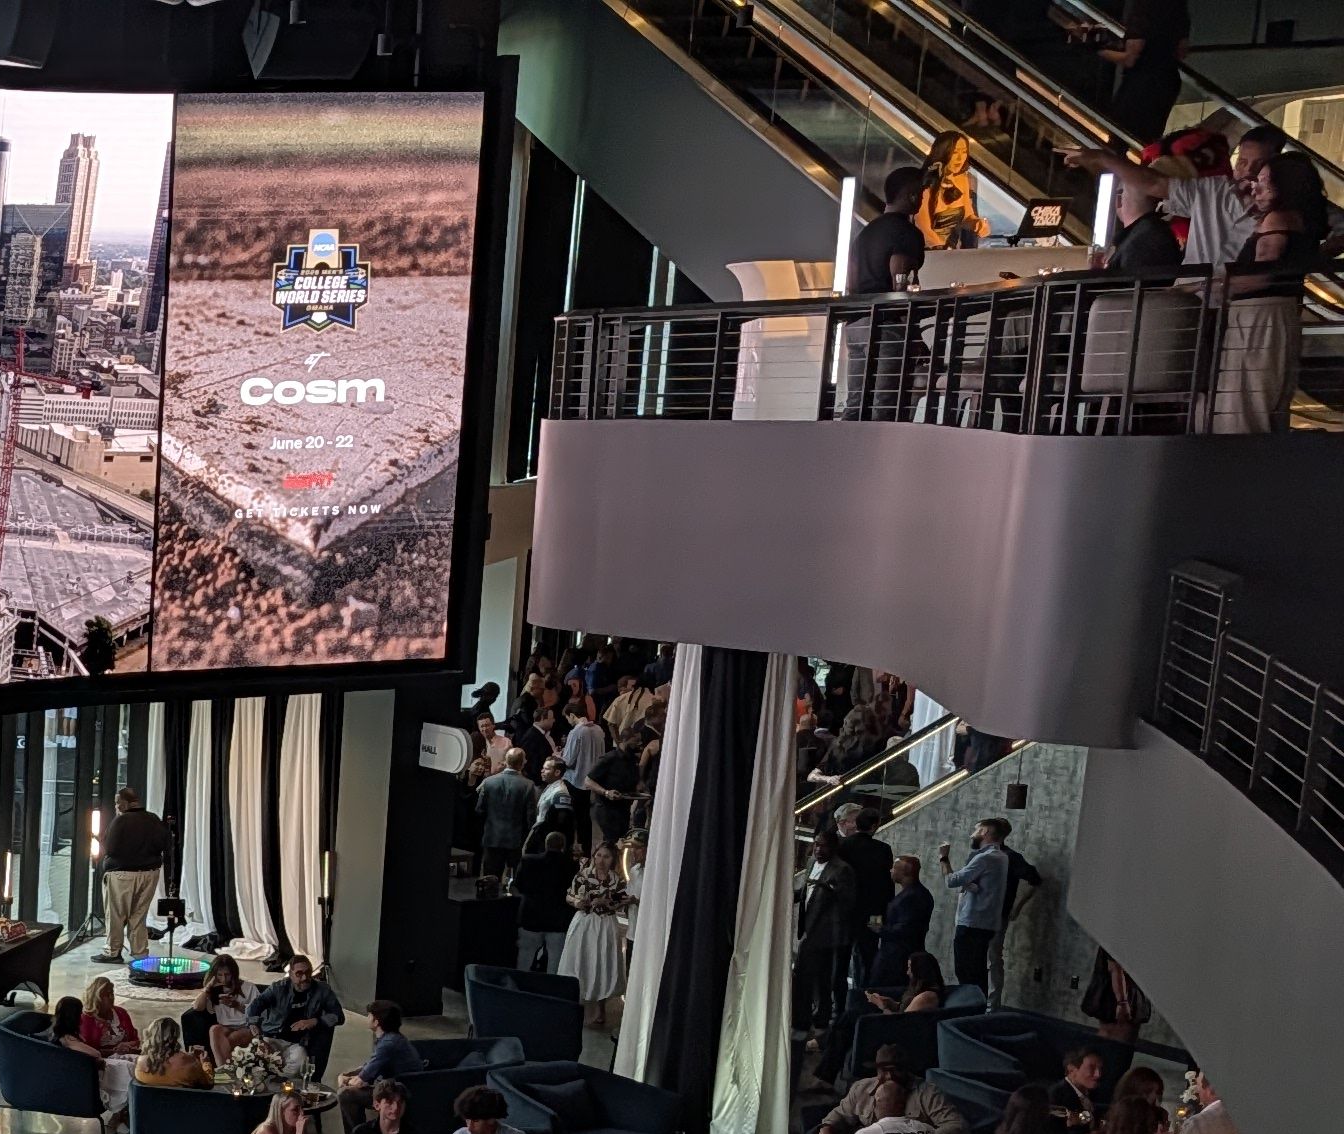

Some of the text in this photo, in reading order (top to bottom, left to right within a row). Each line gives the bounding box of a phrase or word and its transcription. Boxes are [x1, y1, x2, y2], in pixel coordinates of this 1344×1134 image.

[294, 276, 348, 289] COLLEGE
[275, 289, 366, 304] WORLD SERIES
[270, 436, 303, 450] June
[305, 436, 325, 449] 20
[335, 435, 354, 448] 22
[234, 504, 382, 519] GET TICKETS NOW
